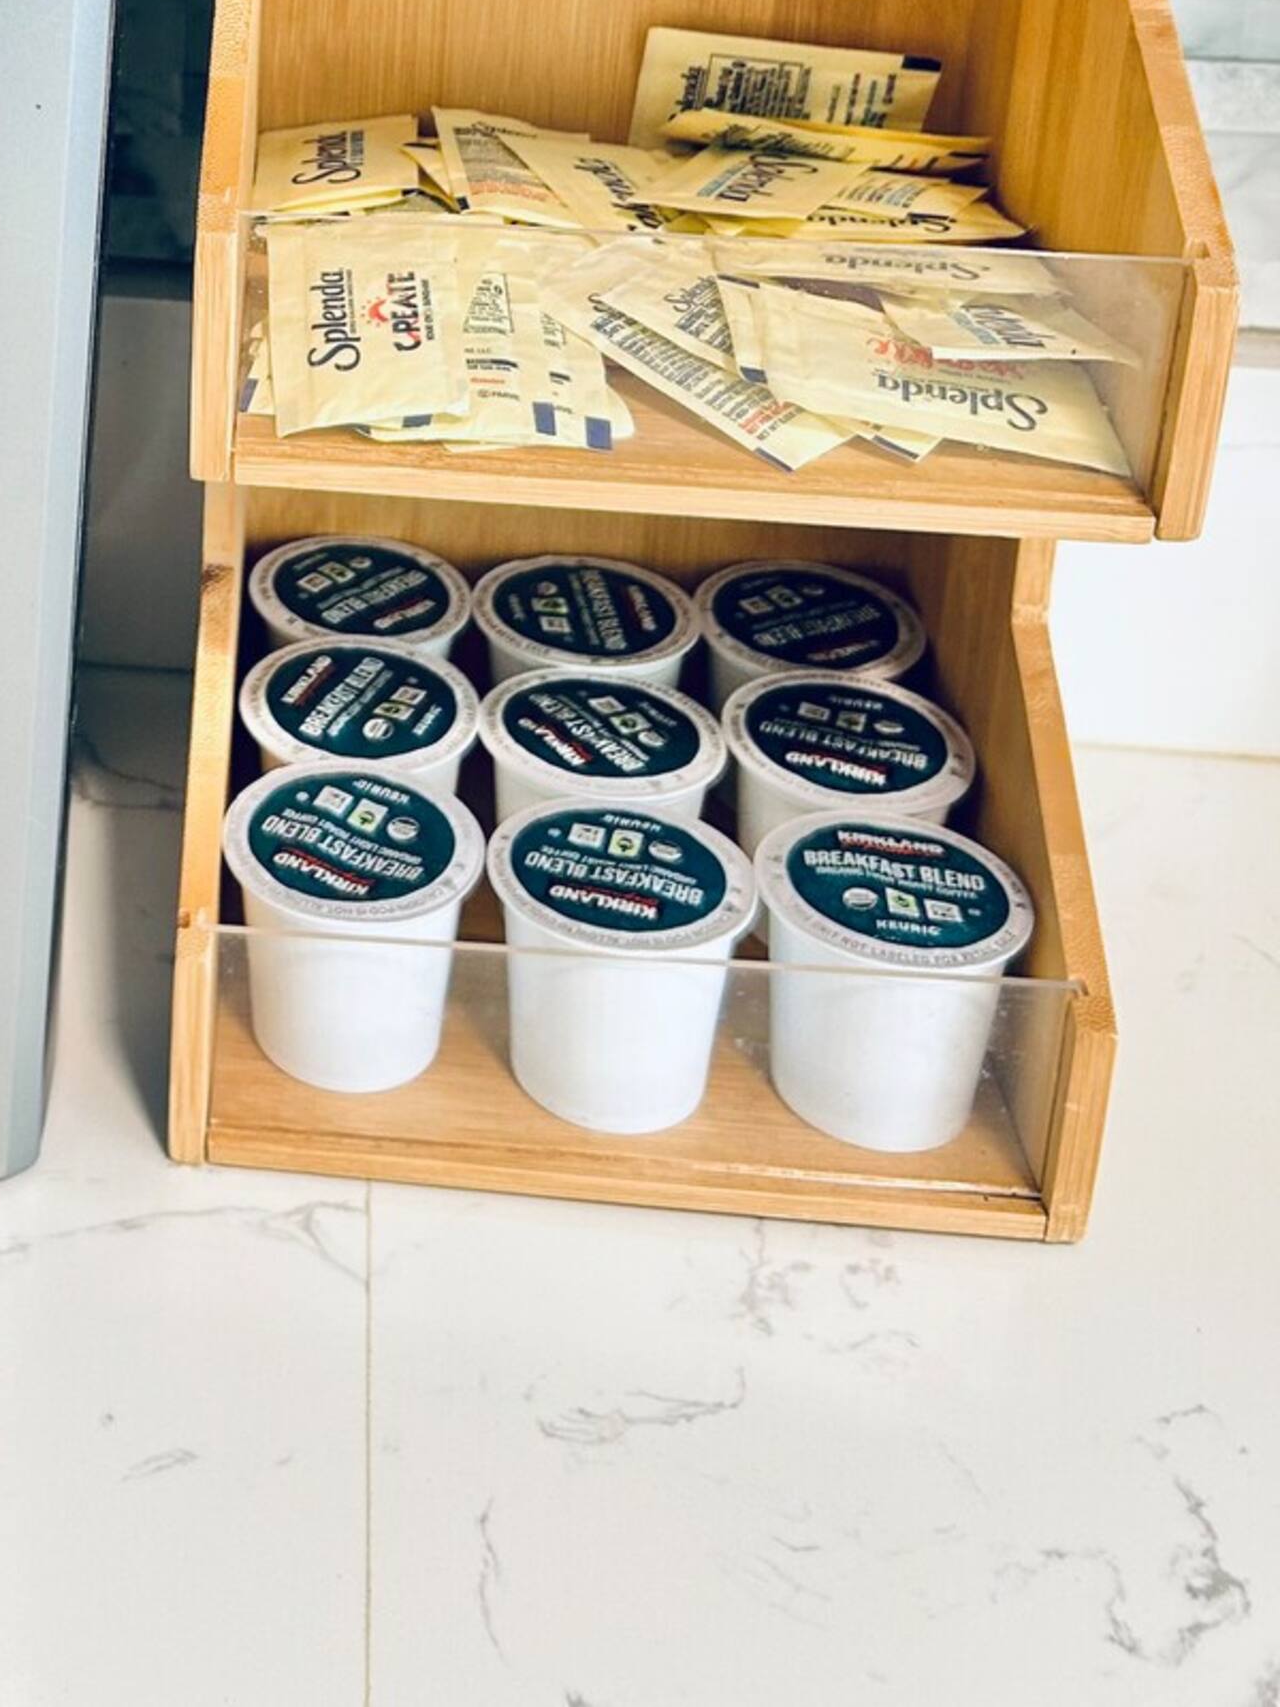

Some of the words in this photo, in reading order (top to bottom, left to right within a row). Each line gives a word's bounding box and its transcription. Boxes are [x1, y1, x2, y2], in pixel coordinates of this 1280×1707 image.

[292, 130, 361, 185] Splenda
[821, 254, 990, 281] Splenda
[307, 269, 361, 372] Splenda
[387, 270, 422, 352] CREATE
[877, 374, 1048, 432] Splenda
[759, 720, 819, 743] BLEND
[785, 750, 887, 786] KIRKLAND
[822, 736, 929, 771] BREAKFAST
[261, 815, 320, 843] BLEND
[837, 830, 945, 854] KIRKLAND
[320, 828, 425, 881] BREAKFAST
[524, 850, 588, 878] BLEND
[803, 850, 916, 881] BREAKFAST
[920, 865, 986, 892] BLEND
[273, 851, 370, 897] KIRKLAND
[592, 867, 704, 906] BREAKFAST
[549, 884, 659, 920] KIRKLAND
[876, 919, 943, 936] KEURIG
